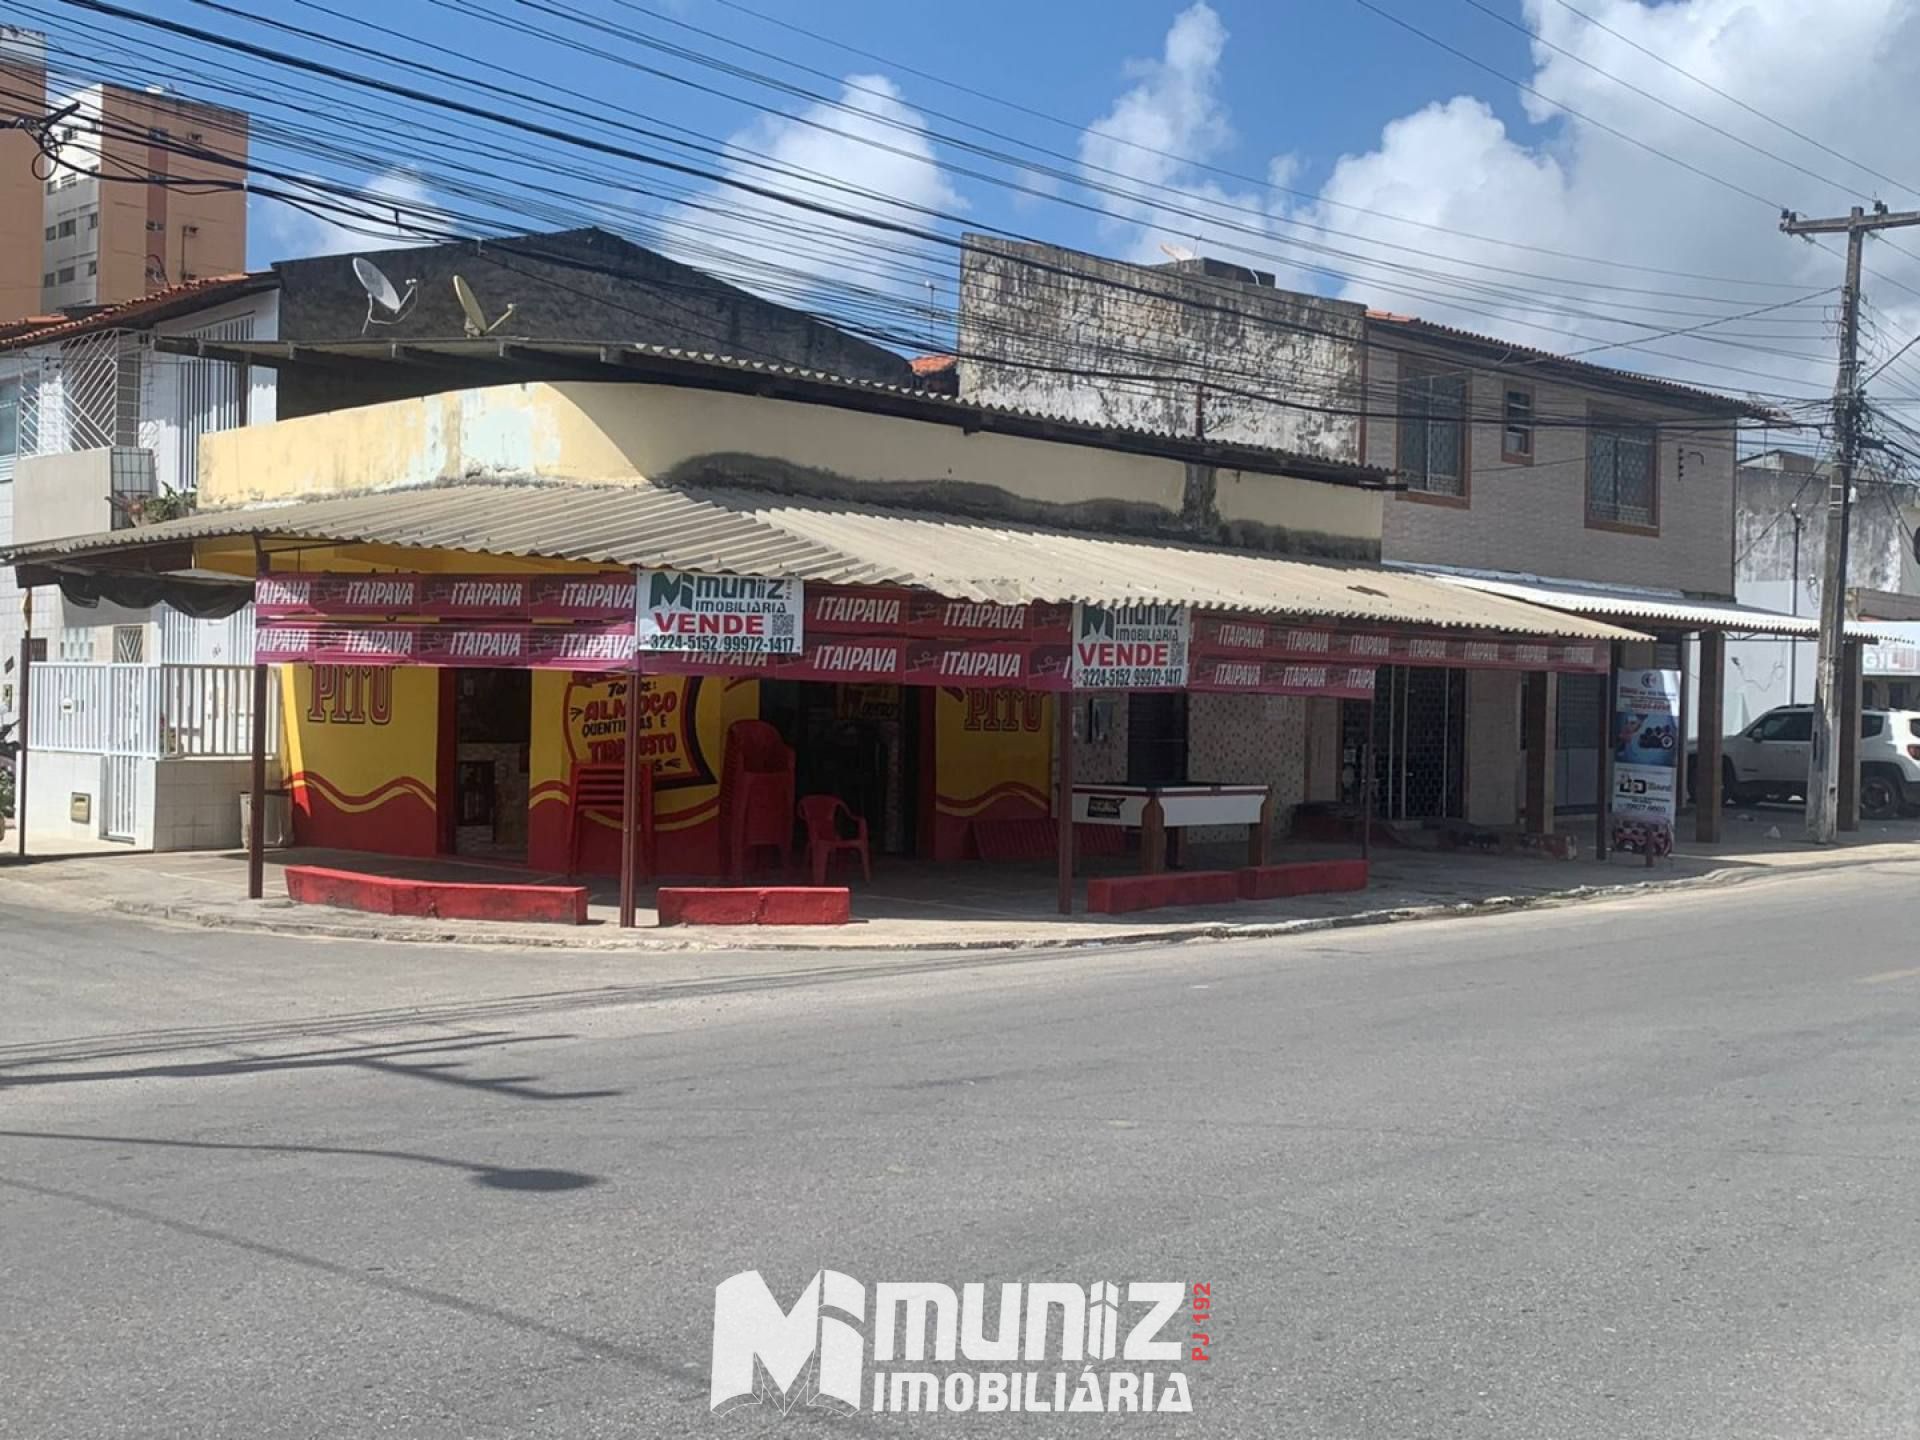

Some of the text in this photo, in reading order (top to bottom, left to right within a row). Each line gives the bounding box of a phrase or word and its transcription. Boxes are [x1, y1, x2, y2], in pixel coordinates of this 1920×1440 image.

[346, 582, 414, 605] ITAIPAVA
[451, 583, 523, 607] ITAIPAVA
[560, 583, 637, 609] ITAIPAVA
[654, 612, 764, 635] VENDE
[815, 596, 1026, 629] ITAIPAVA ITAIPAVA
[345, 630, 413, 654] ITAIPAVA
[450, 631, 521, 656] ITAIPAVA
[559, 633, 637, 659] ITAIPAVA
[1218, 624, 1265, 649] ITAIPAVA
[1286, 631, 1329, 653] ITAIPAVA
[813, 645, 1022, 678] ITAIPAVA ITAIPAVA
[1077, 643, 1169, 667] VENDE
[1214, 664, 1261, 686] ITAIPAVA
